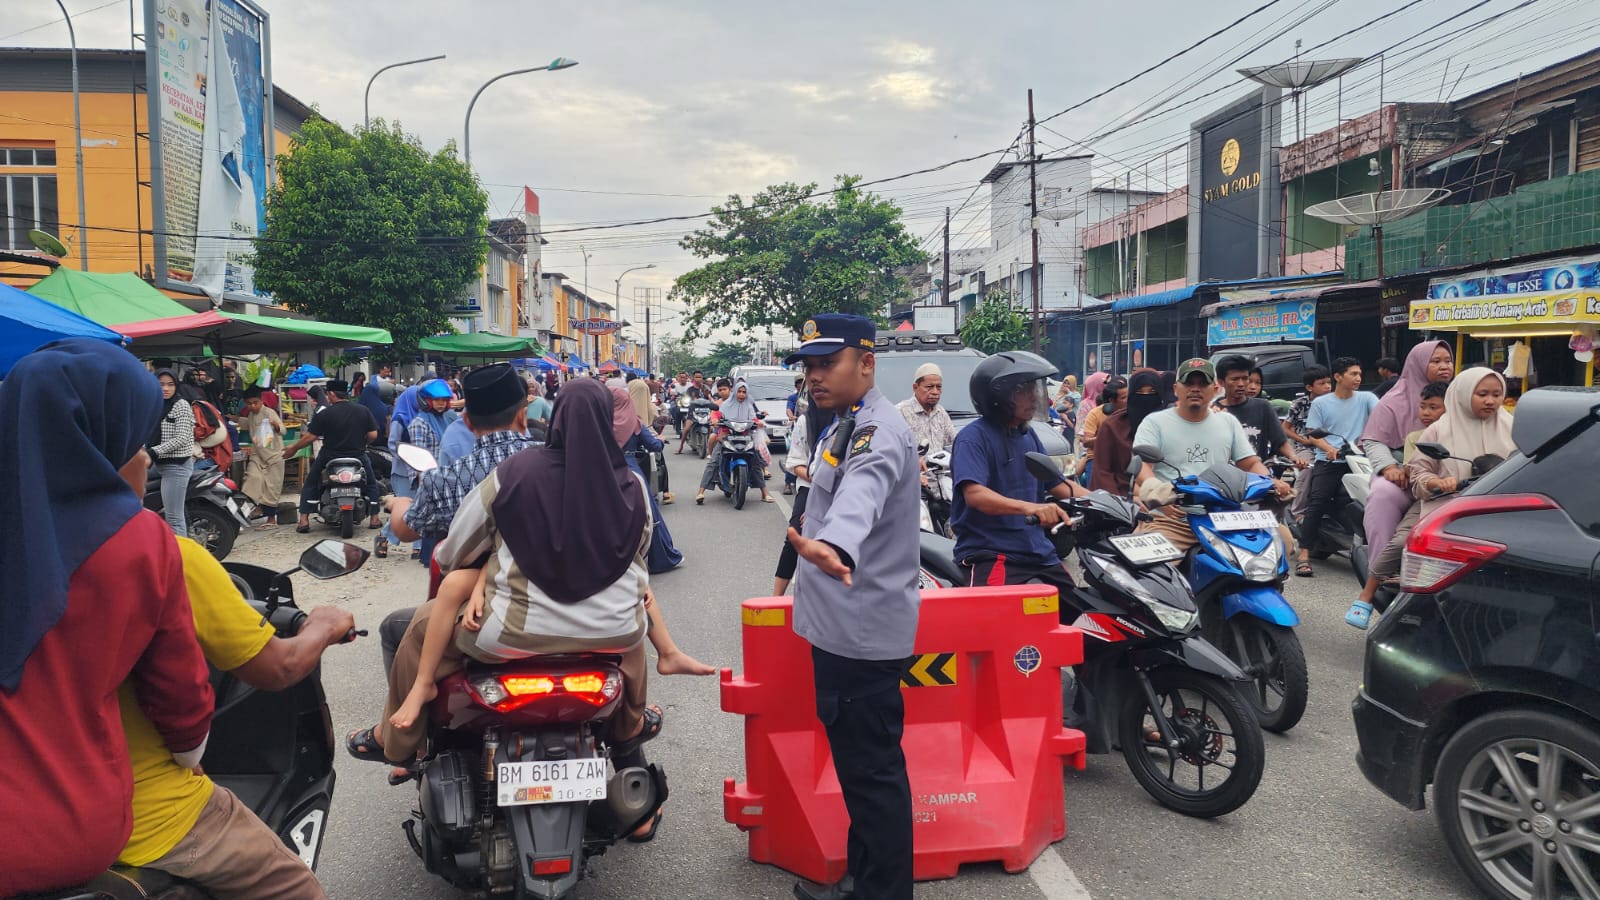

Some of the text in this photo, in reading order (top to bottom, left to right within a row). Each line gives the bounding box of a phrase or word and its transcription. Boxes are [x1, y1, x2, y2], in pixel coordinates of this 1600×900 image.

[1204, 171, 1261, 204] SYAM GOLD
[1517, 278, 1543, 292] ESSE
[1433, 298, 1548, 322] Tahu Terbalik & Kentang Arab
[1242, 314, 1279, 330] SYARIF
[1116, 616, 1145, 636] HONDA
[500, 761, 604, 784] BM 6161 ZAW
[918, 792, 977, 806] KAMPAR
